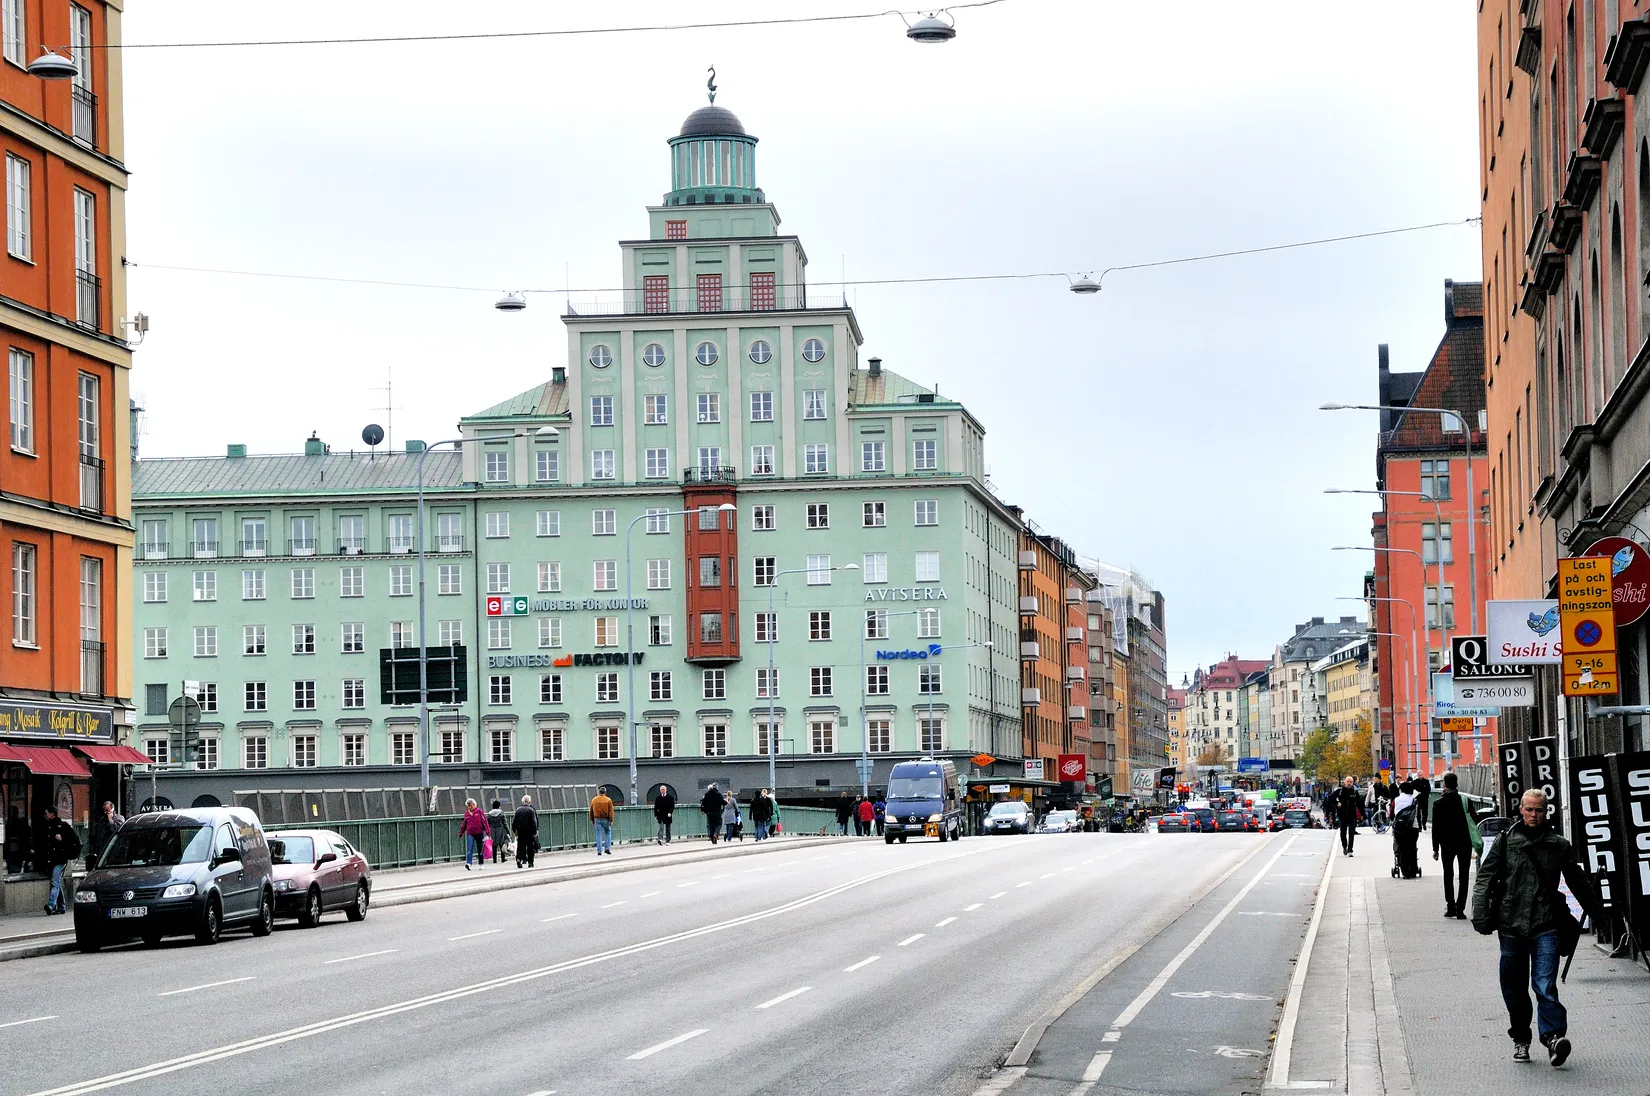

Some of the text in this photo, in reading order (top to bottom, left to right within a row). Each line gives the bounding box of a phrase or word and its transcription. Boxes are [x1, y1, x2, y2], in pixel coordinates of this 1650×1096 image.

[1573, 560, 1597, 570] Last
[1565, 573, 1606, 586] på och
[1565, 587, 1608, 598] avstig-
[531, 598, 578, 612] MÖBLER
[580, 598, 601, 611] FÖR
[1562, 601, 1612, 613] ningszon
[876, 649, 928, 661] Nordea
[1459, 639, 1488, 666] Q
[1501, 642, 1548, 658] Sushi
[487, 653, 551, 668] BUSINESS
[1575, 658, 1604, 669] 9-16
[1460, 664, 1526, 676] SALONG
[1477, 686, 1527, 698] 736 00 80
[76, 712, 83, 734] &
[83, 713, 100, 737] Bar
